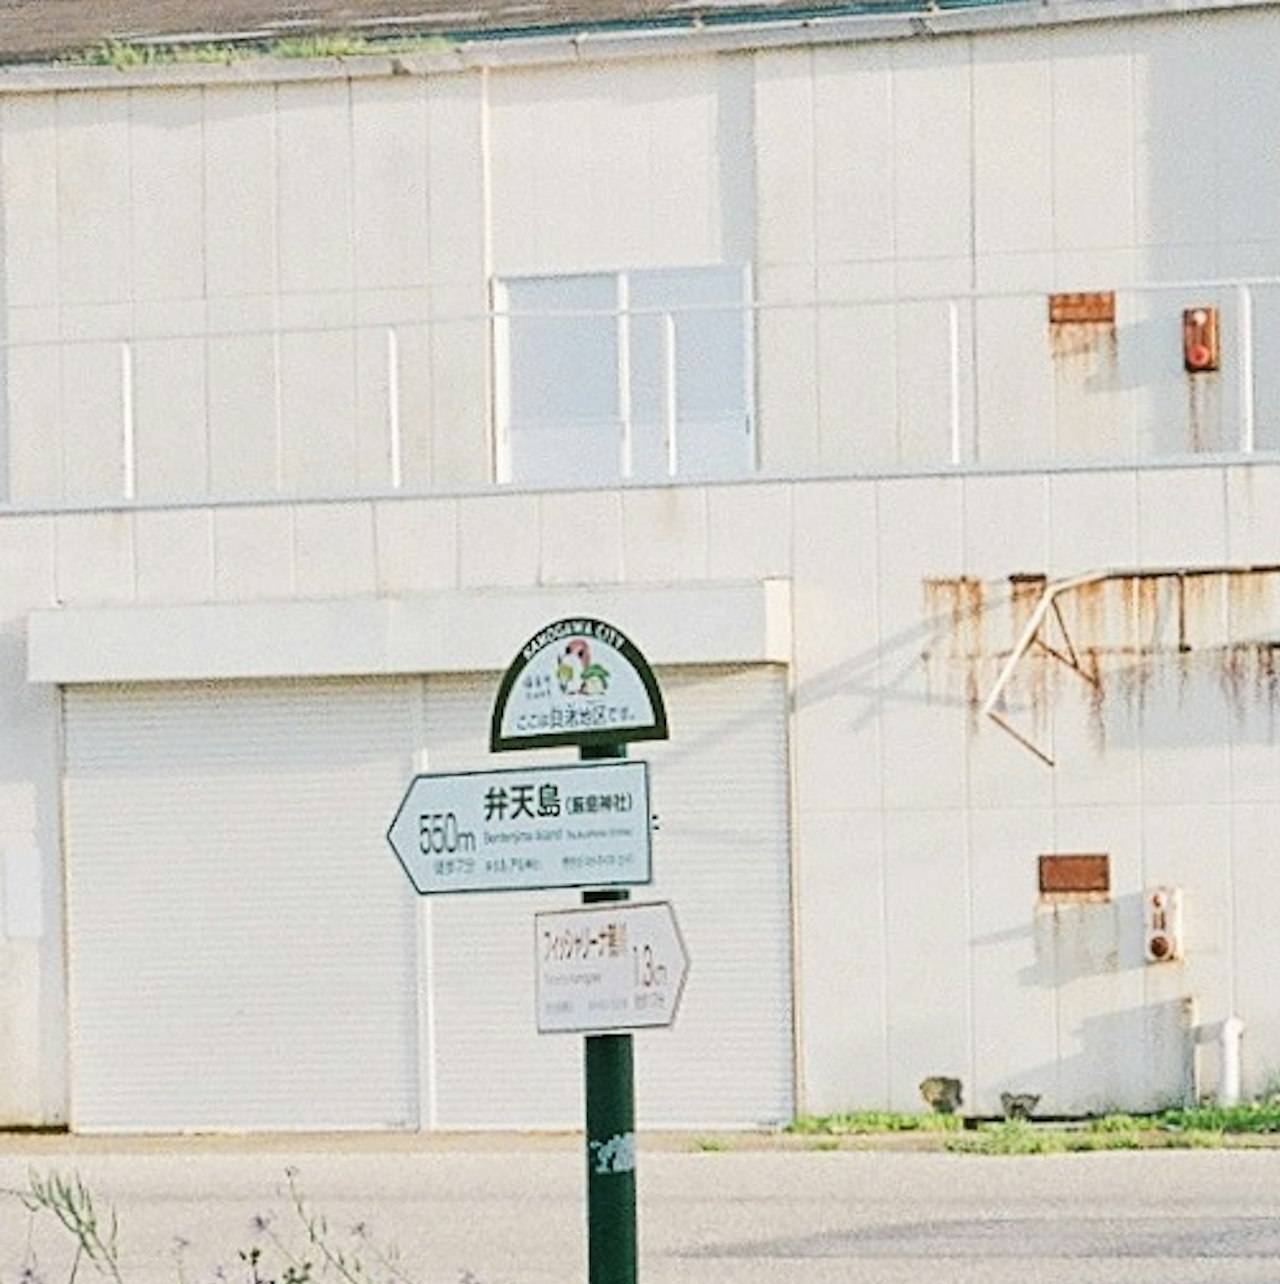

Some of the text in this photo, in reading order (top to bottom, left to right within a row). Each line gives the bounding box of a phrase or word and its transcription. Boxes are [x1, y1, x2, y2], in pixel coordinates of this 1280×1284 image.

[484, 784, 561, 821] 弁天島
[419, 812, 476, 855] 550m
